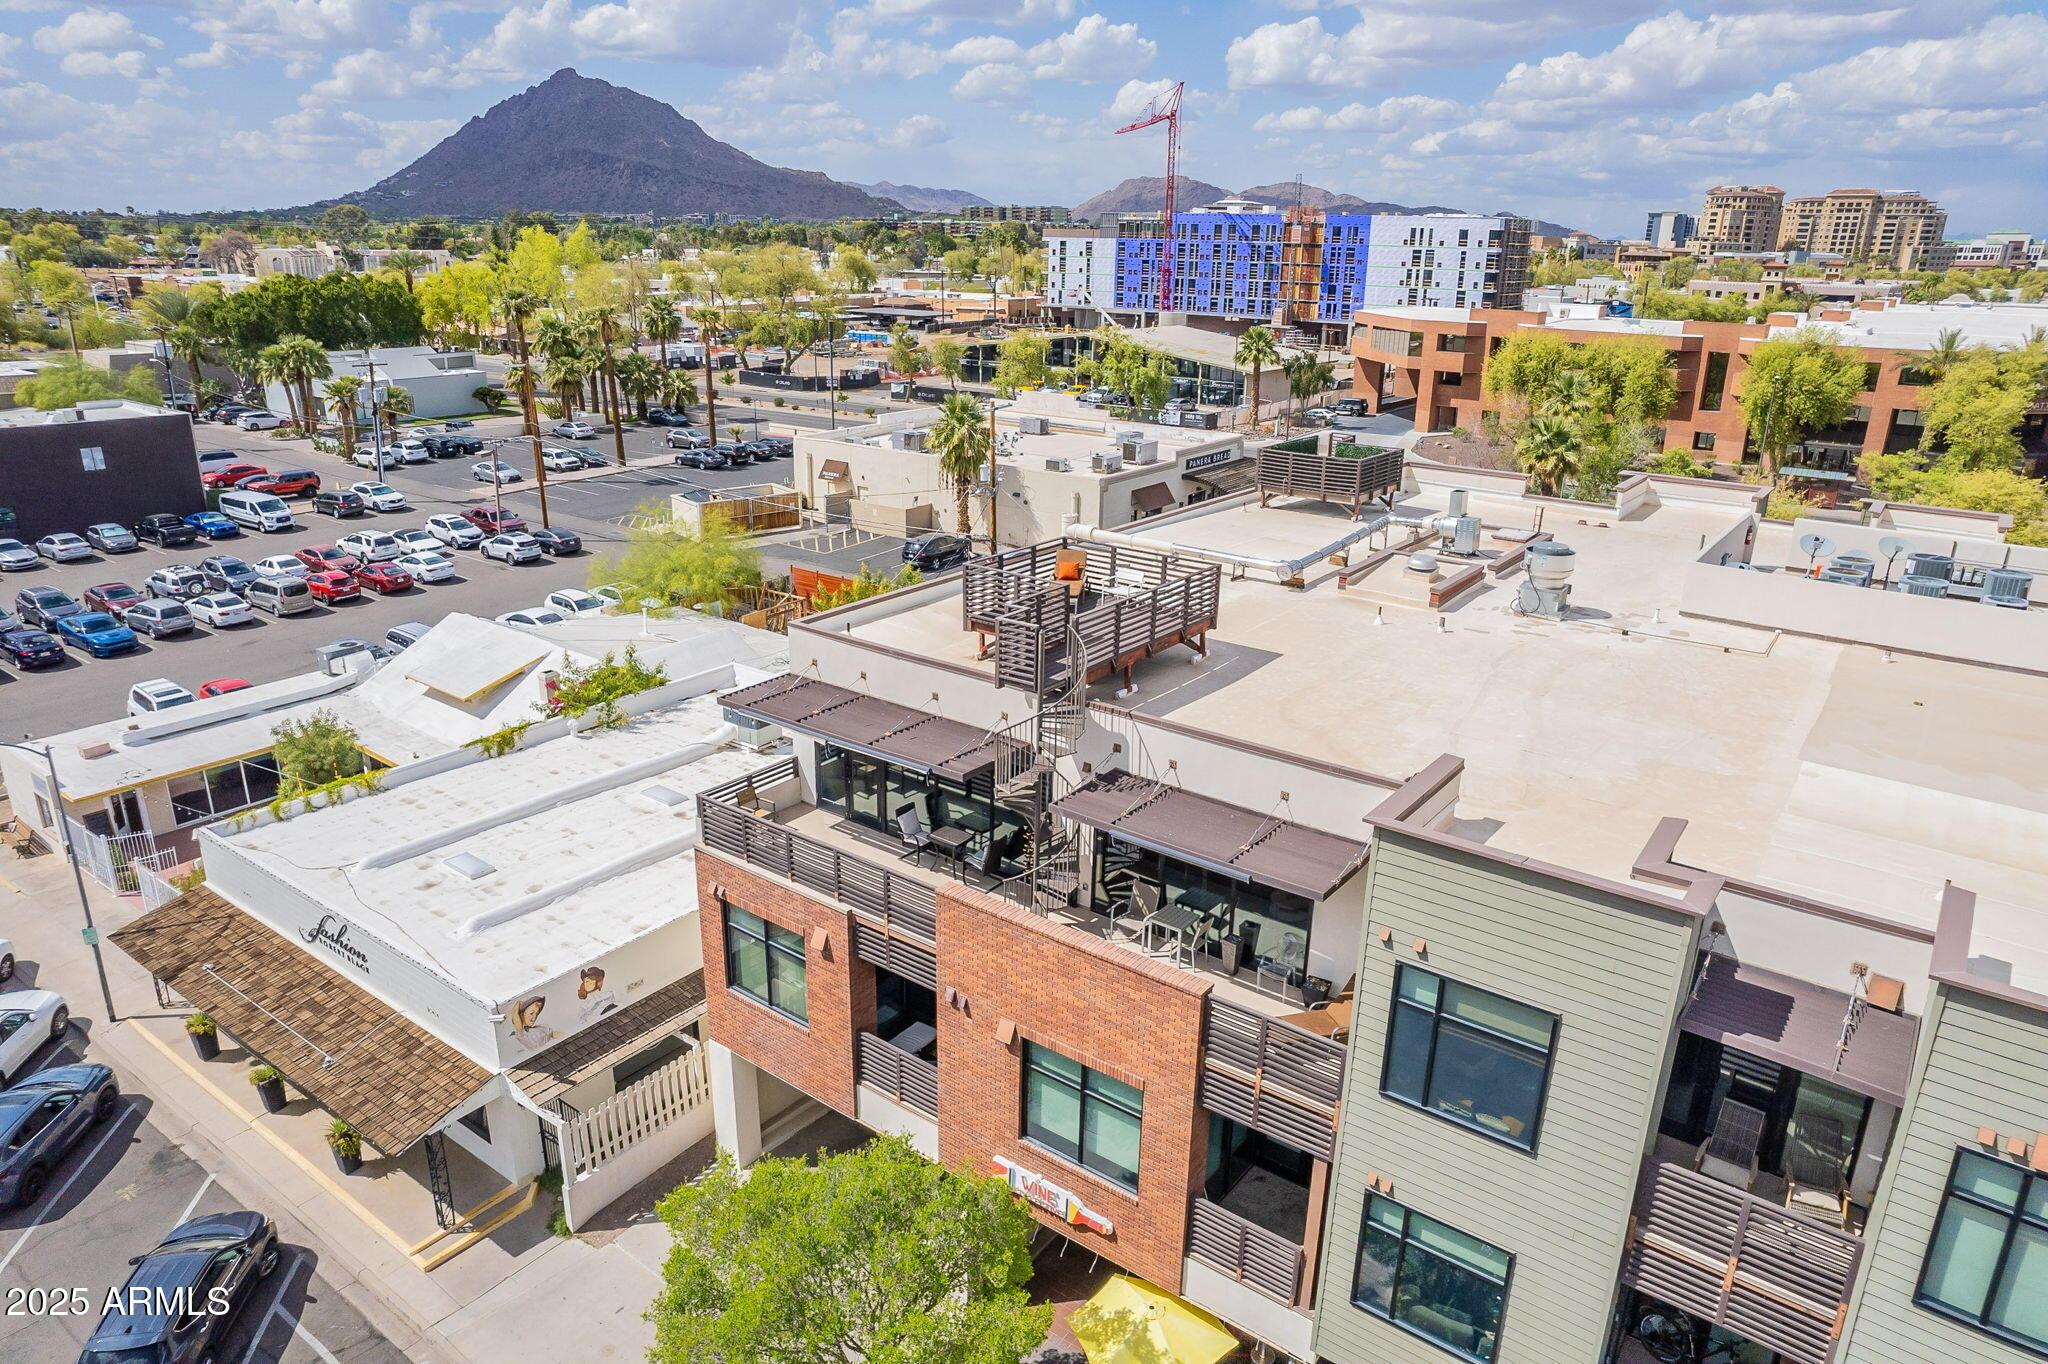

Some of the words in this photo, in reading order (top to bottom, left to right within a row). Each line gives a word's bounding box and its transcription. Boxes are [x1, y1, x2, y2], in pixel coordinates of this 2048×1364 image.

[1189, 457, 1211, 467] PANERA
[1213, 451, 1231, 462] BREAD
[1021, 1175, 1056, 1206] WINE
